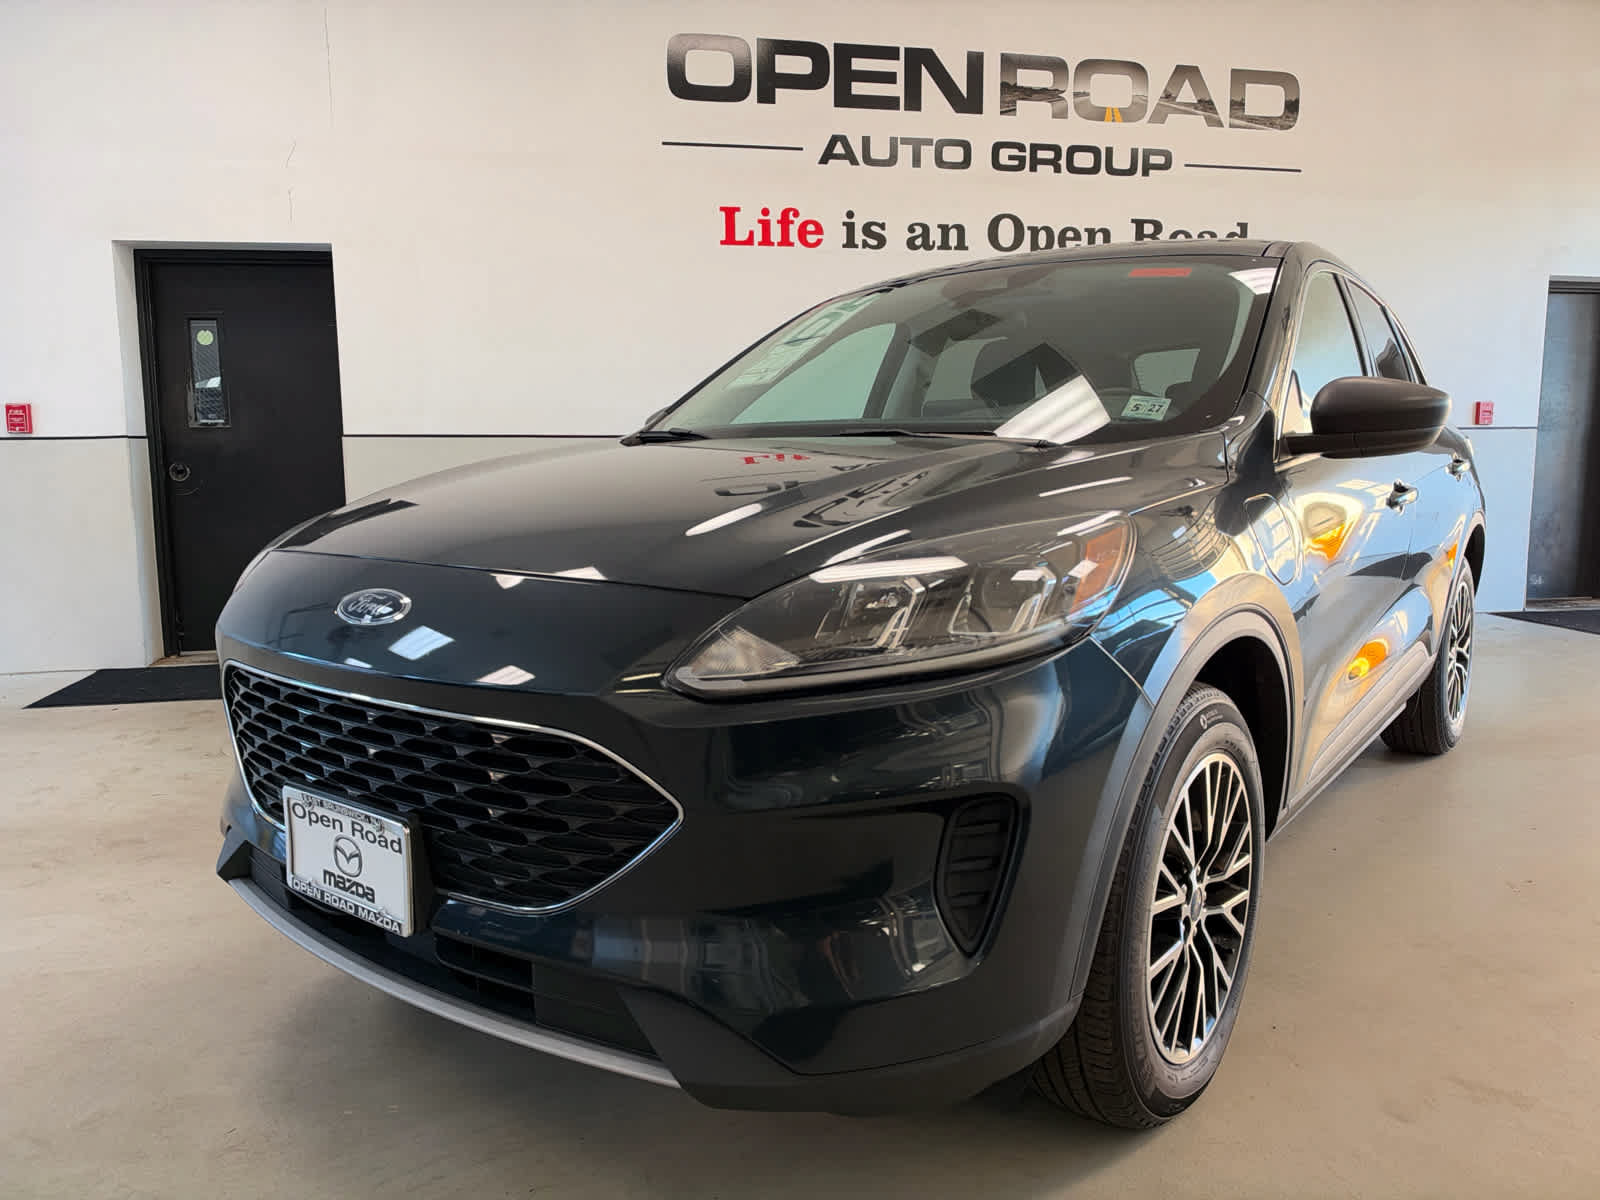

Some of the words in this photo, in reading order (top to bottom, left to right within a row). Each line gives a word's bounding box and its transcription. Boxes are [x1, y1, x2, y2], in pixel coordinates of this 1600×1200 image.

[667, 33, 985, 115] OPEN
[1000, 52, 1301, 131] ROAD
[817, 134, 972, 170] AUTO
[991, 140, 1173, 177] GROUP
[719, 206, 824, 248] Life
[842, 210, 887, 250] is
[906, 222, 968, 251] an
[987, 213, 1112, 252] Open
[1131, 218, 1249, 241] Rd
[291, 802, 343, 833] Open
[351, 820, 403, 855] Road
[293, 878, 321, 899] OPEN
[324, 890, 356, 915] ROAD
[358, 907, 401, 934] MAZDA
